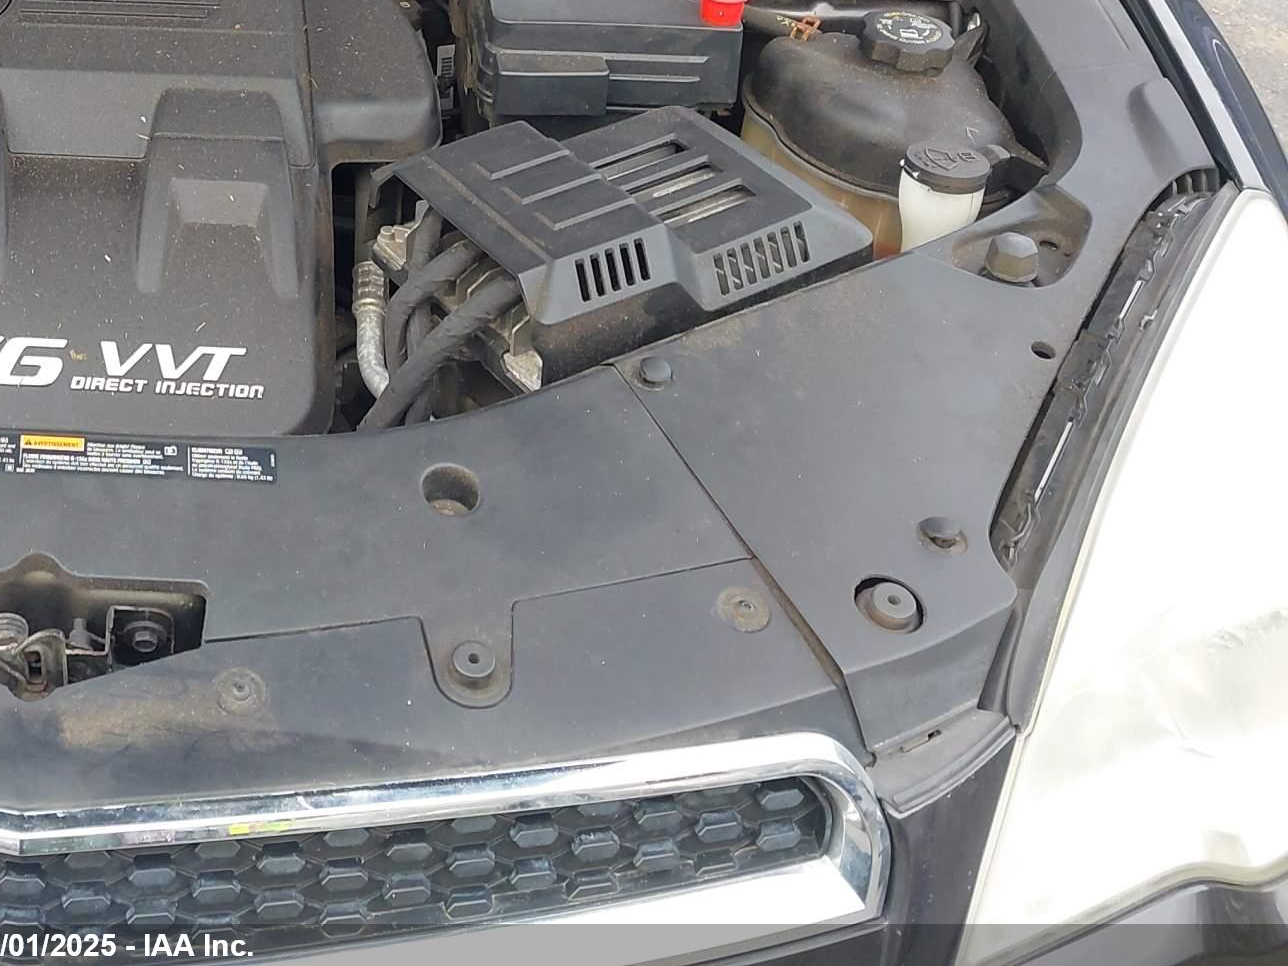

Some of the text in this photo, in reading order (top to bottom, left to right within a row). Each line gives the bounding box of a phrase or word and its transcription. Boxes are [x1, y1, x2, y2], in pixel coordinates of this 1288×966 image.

[101, 340, 248, 381] VVT
[70, 376, 265, 400] DIRECT INJECTION
